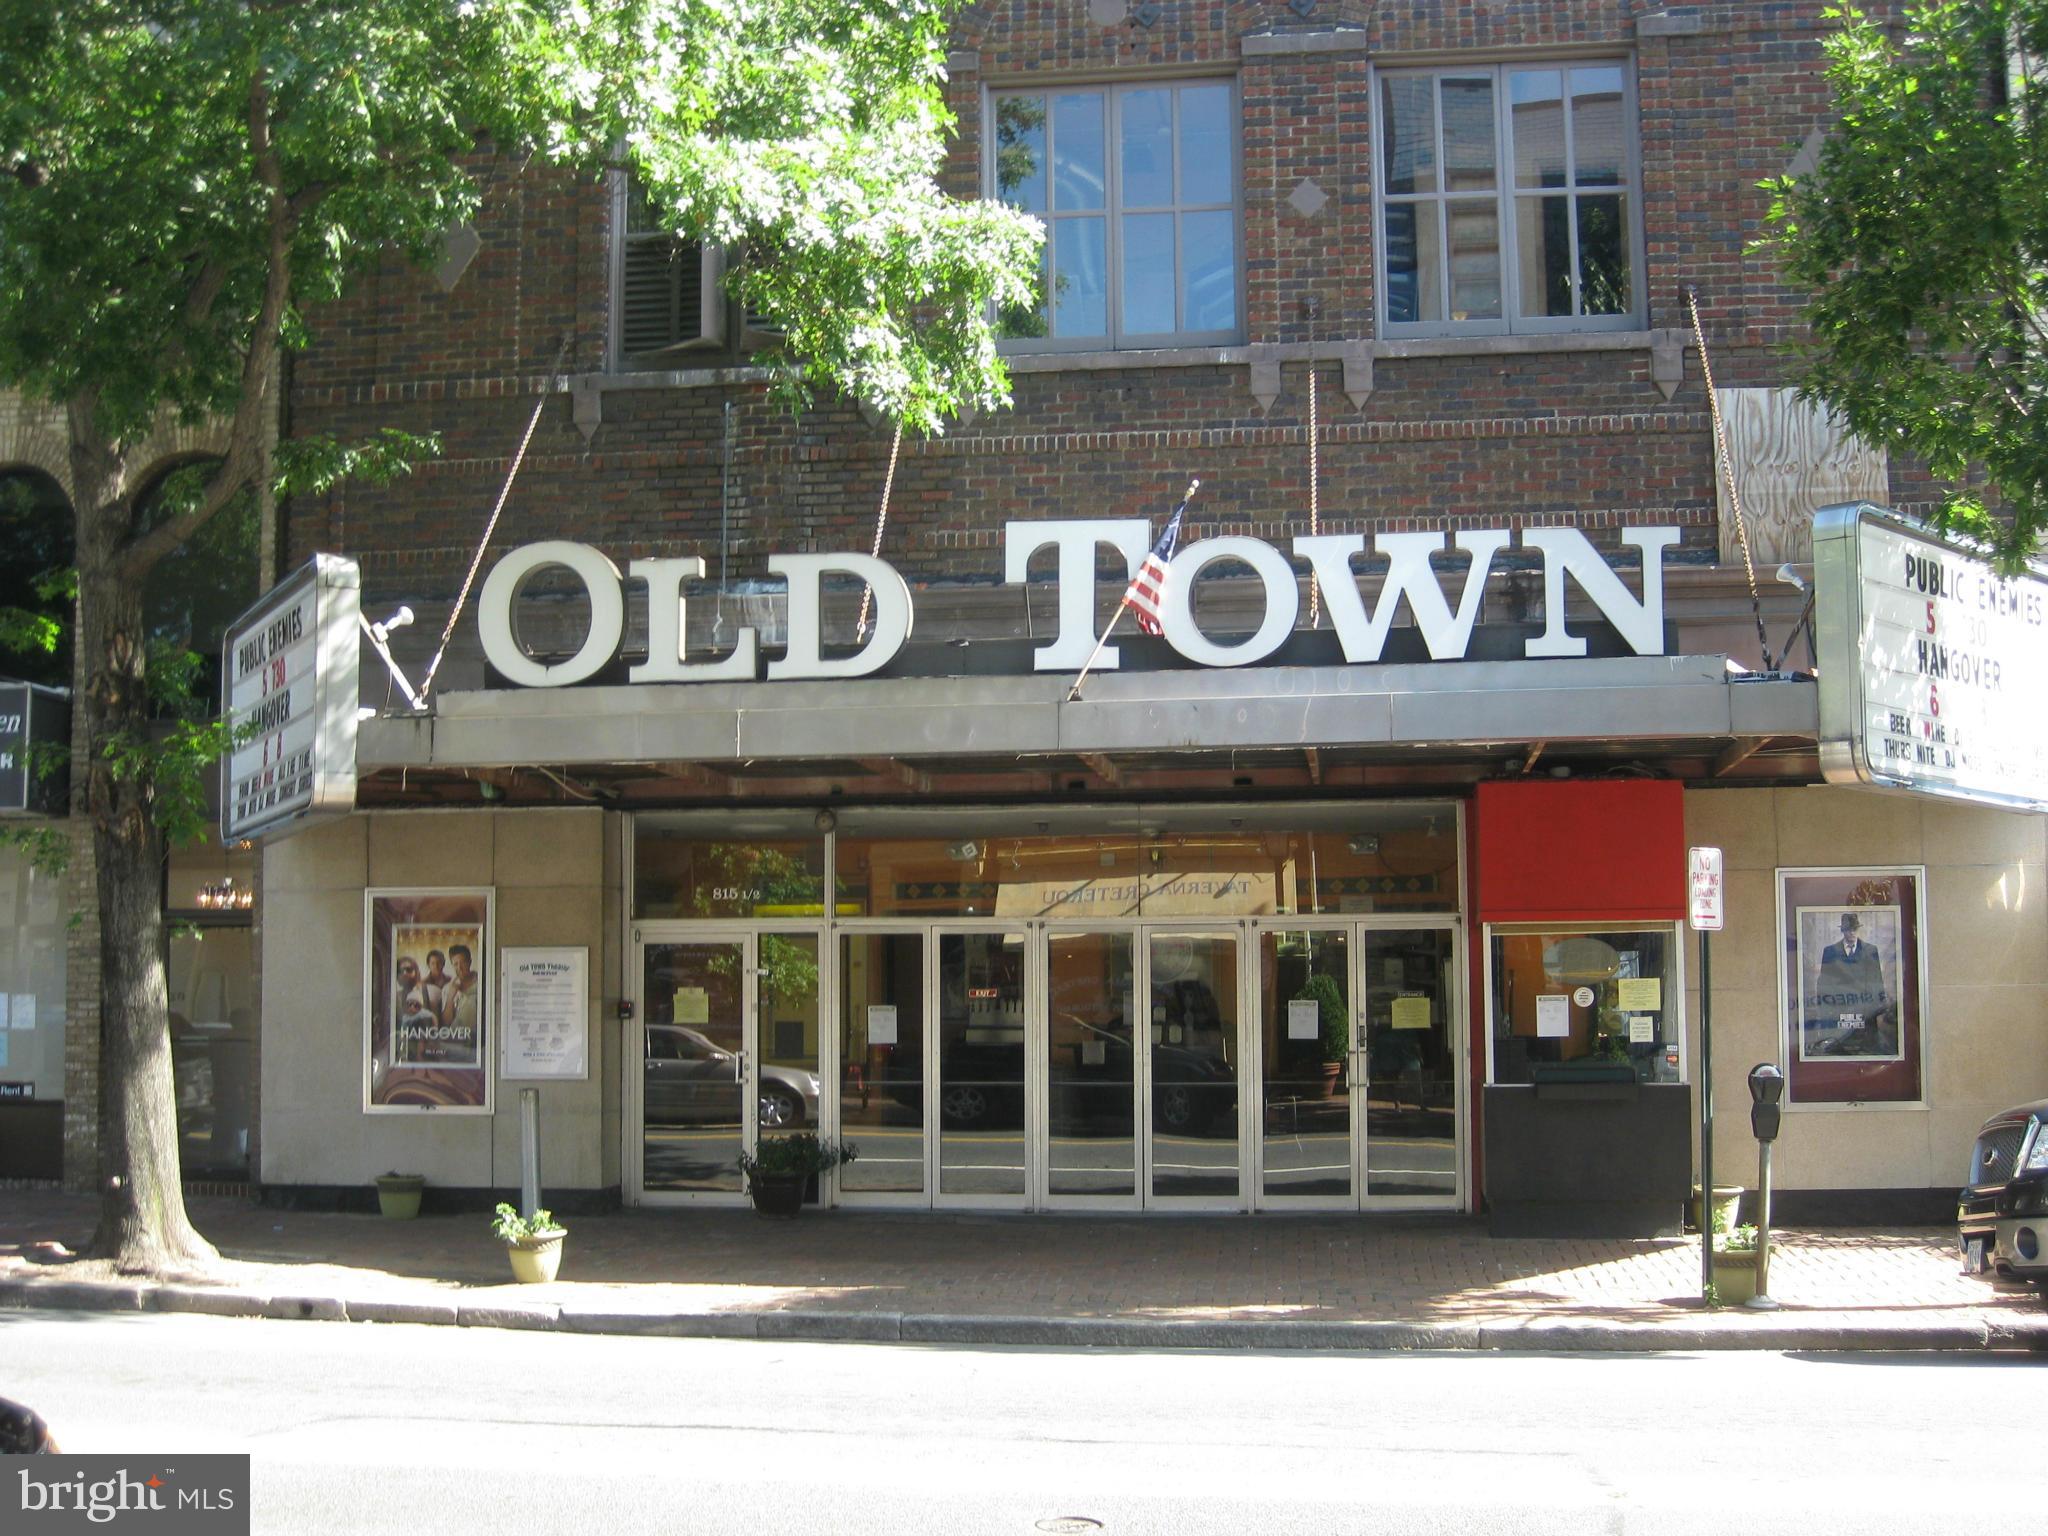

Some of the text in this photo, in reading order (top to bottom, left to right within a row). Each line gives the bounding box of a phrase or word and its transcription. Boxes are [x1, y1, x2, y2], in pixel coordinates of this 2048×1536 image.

[478, 519, 1681, 688] OLD TOWN
[1905, 553, 2042, 626] PUBLIC ENEMIES
[1926, 599, 1936, 635] 5
[239, 605, 302, 678] PUBLIC ENEMIES
[262, 656, 286, 699] 5 730
[1918, 639, 2002, 692] HANGOVER
[1930, 684, 1940, 718] 6
[1890, 713, 1912, 737] BEER
[1924, 720, 1946, 743] WINE
[1884, 738, 1911, 760] THURS
[1917, 744, 1936, 766] NITE
[1692, 871, 1719, 886] PARING
[1699, 857, 1711, 871] NO
[712, 887, 760, 901] 815 1/2
[400, 1026, 471, 1040] HANGOVER
